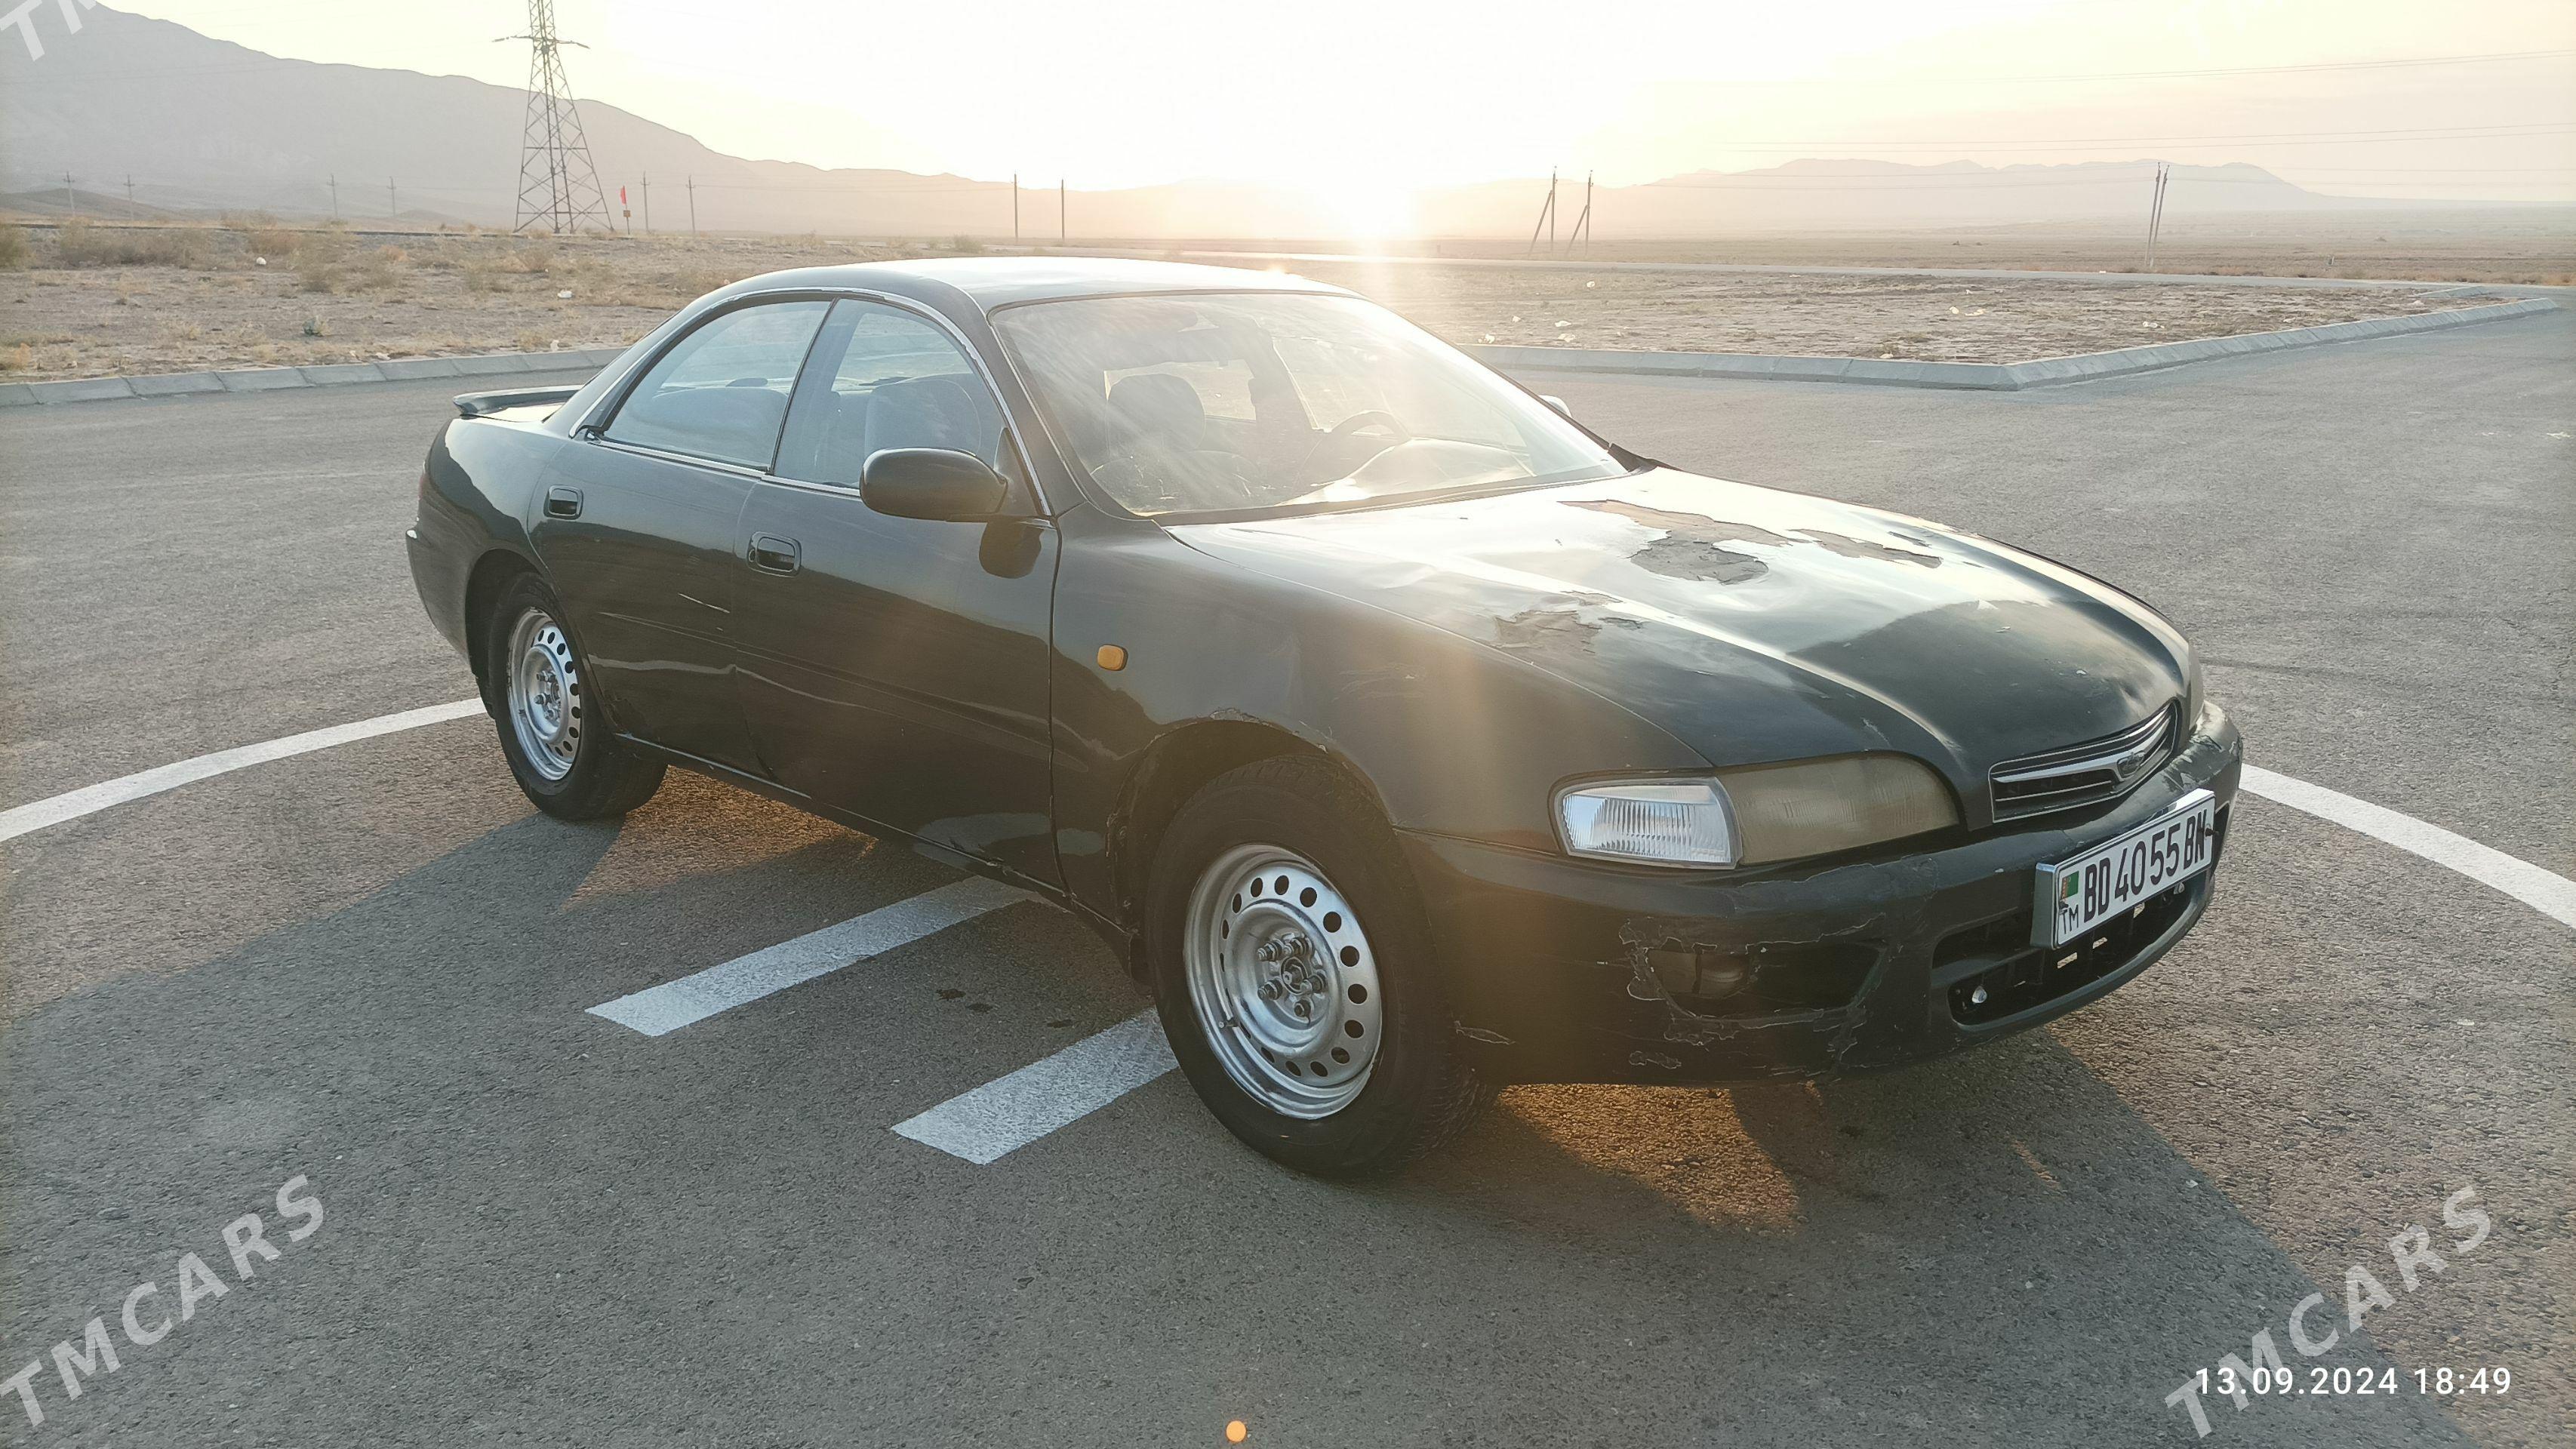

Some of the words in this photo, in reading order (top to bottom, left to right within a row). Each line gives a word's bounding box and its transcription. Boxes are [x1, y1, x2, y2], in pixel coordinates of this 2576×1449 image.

[2085, 858, 2110, 923] BD
[2115, 823, 2181, 902] 4055
[2184, 809, 2207, 870] BN
[2061, 905, 2079, 934] TM
